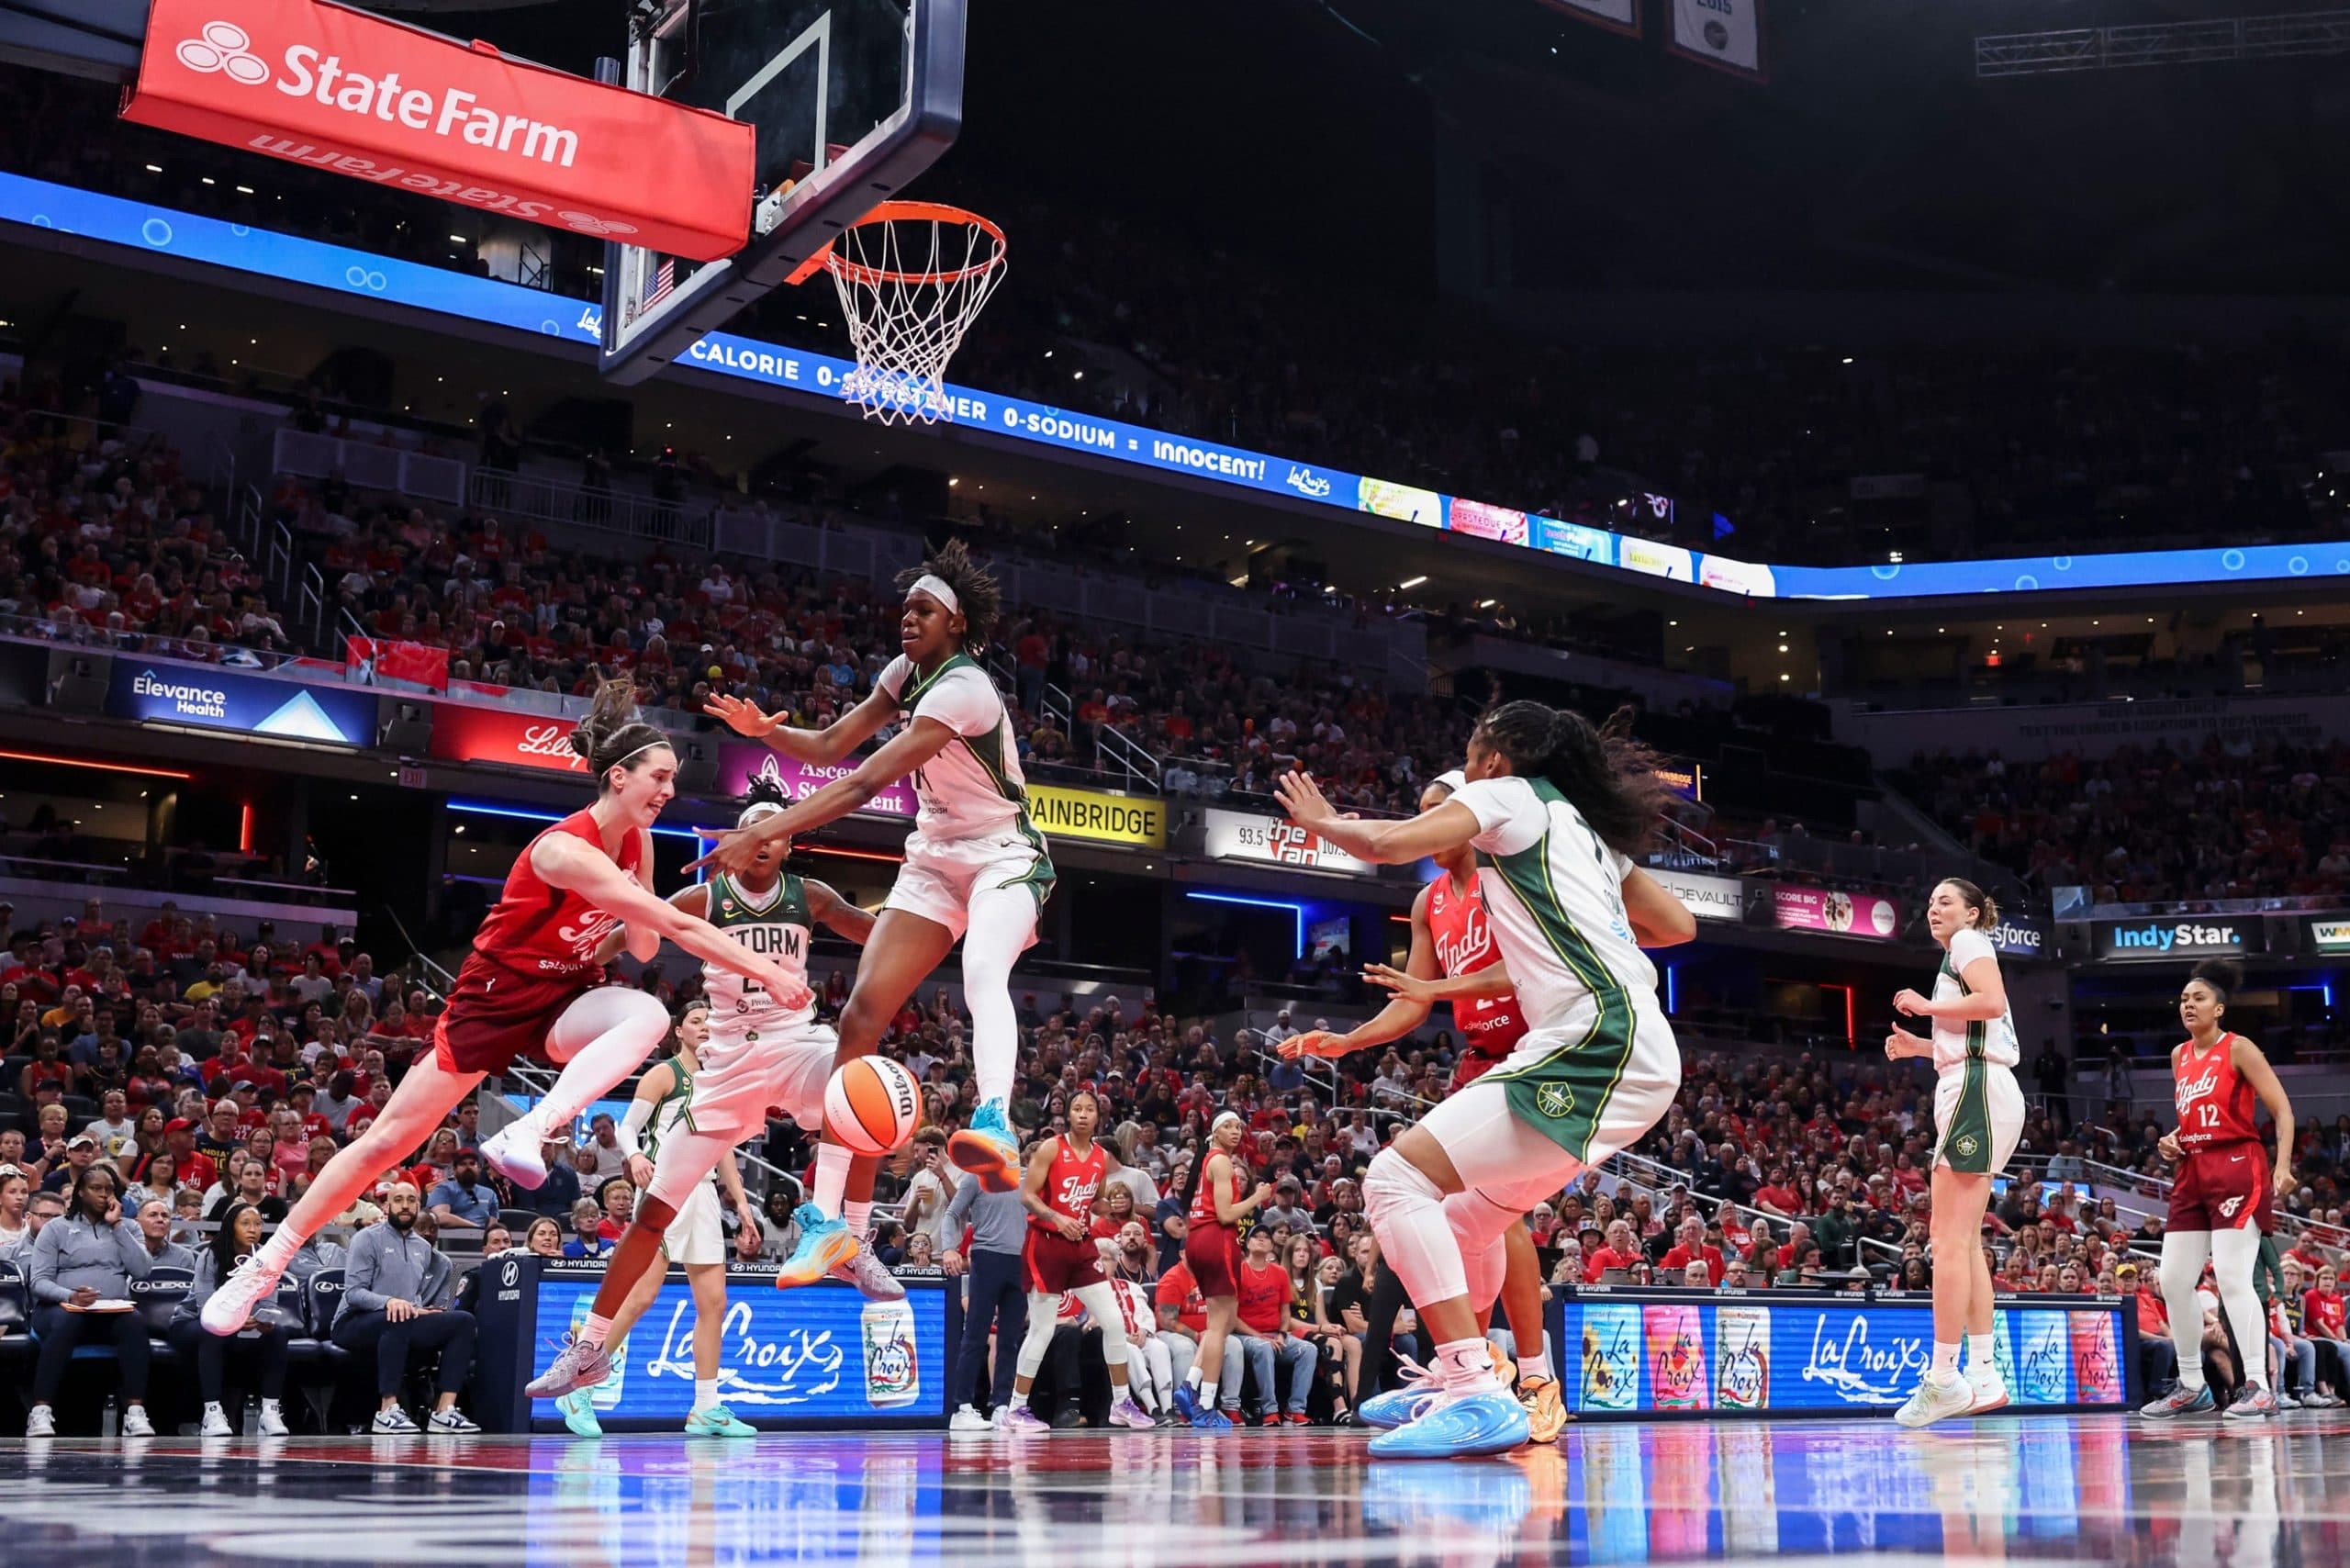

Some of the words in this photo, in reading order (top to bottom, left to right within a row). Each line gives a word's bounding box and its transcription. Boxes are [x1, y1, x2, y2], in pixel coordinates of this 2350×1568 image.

[689, 340, 799, 380] CALORIE
[1003, 408, 1114, 449] 0-SODIUM
[133, 676, 226, 704] Elevance
[177, 700, 224, 719] Health
[1027, 797, 1156, 836] AINBRIDGE
[1266, 817, 1306, 845] the
[1239, 828, 1263, 846] 93.5
[1276, 841, 1319, 866] fan
[1775, 891, 1802, 902] SCORE
[1804, 895, 1817, 904] BIG
[729, 927, 800, 959] TORM
[1984, 922, 2041, 948] esforce
[881, 1058, 913, 1119] Wilson
[2176, 1066, 2219, 1110] Indy
[2197, 1103, 2221, 1127] 12
[186, 1171, 201, 1189] dy
[567, 1260, 607, 1268] HYUNDAI
[498, 1289, 520, 1300] HYUNDAI
[1606, 1320, 1630, 1365] La
[1739, 1323, 1761, 1366] La
[2040, 1324, 2058, 1364] La
[1656, 1351, 1701, 1401] Croix
[1719, 1355, 1763, 1401] Croix
[2024, 1351, 2063, 1394] Croix
[2079, 1353, 2115, 1396] Croix
